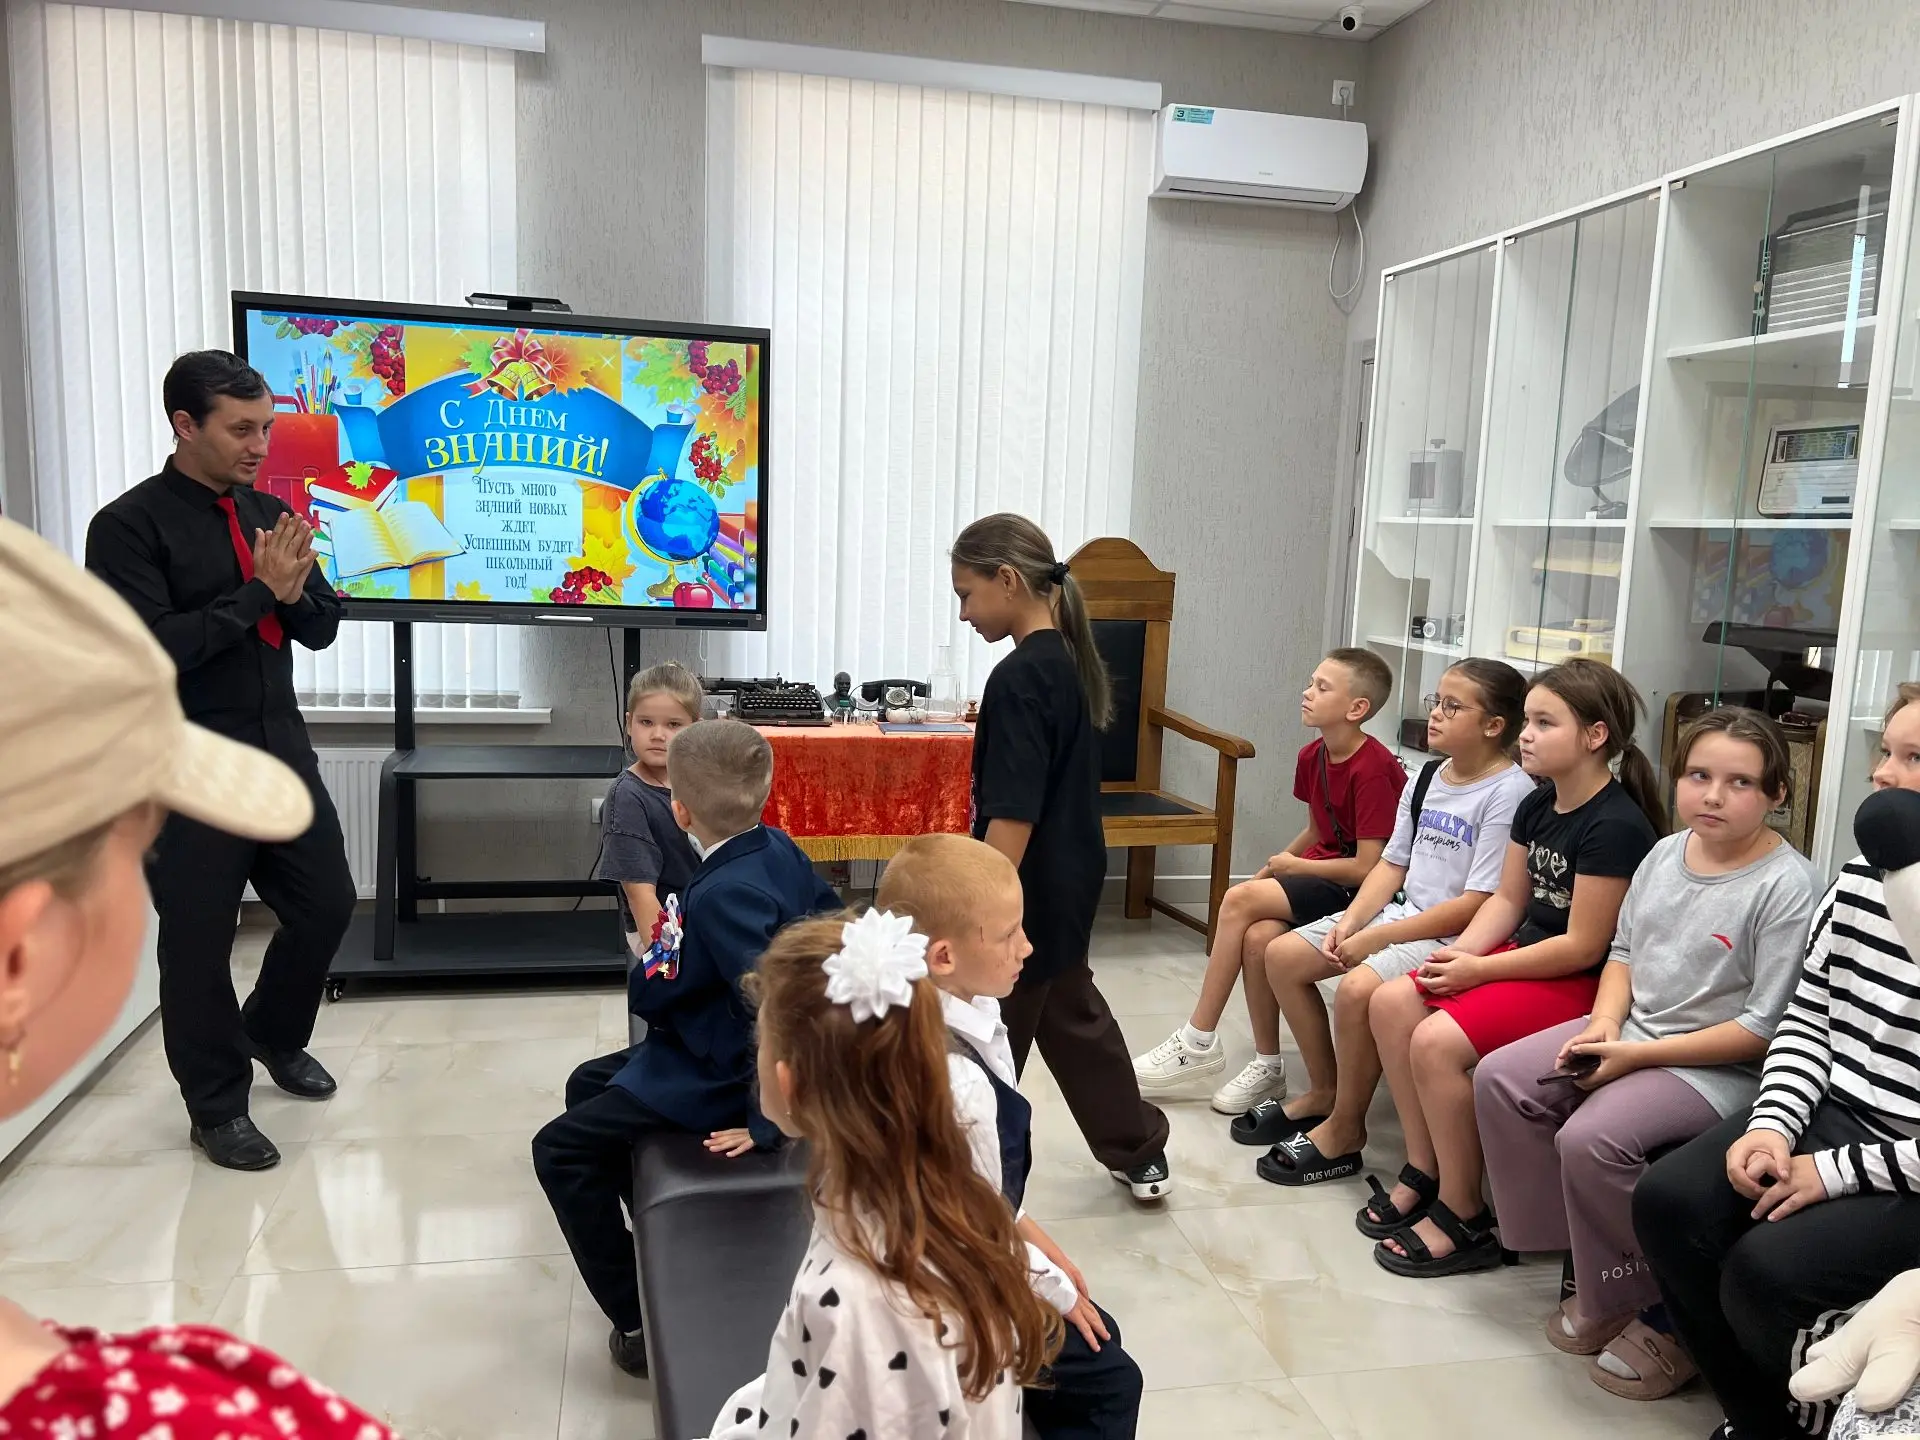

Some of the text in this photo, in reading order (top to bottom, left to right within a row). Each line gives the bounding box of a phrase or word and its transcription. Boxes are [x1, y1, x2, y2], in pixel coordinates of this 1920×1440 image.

[439, 399, 464, 430] С
[424, 431, 610, 477] ЗНАНИЙ!
[1303, 1163, 1353, 1182] LOUIS VUITTON
